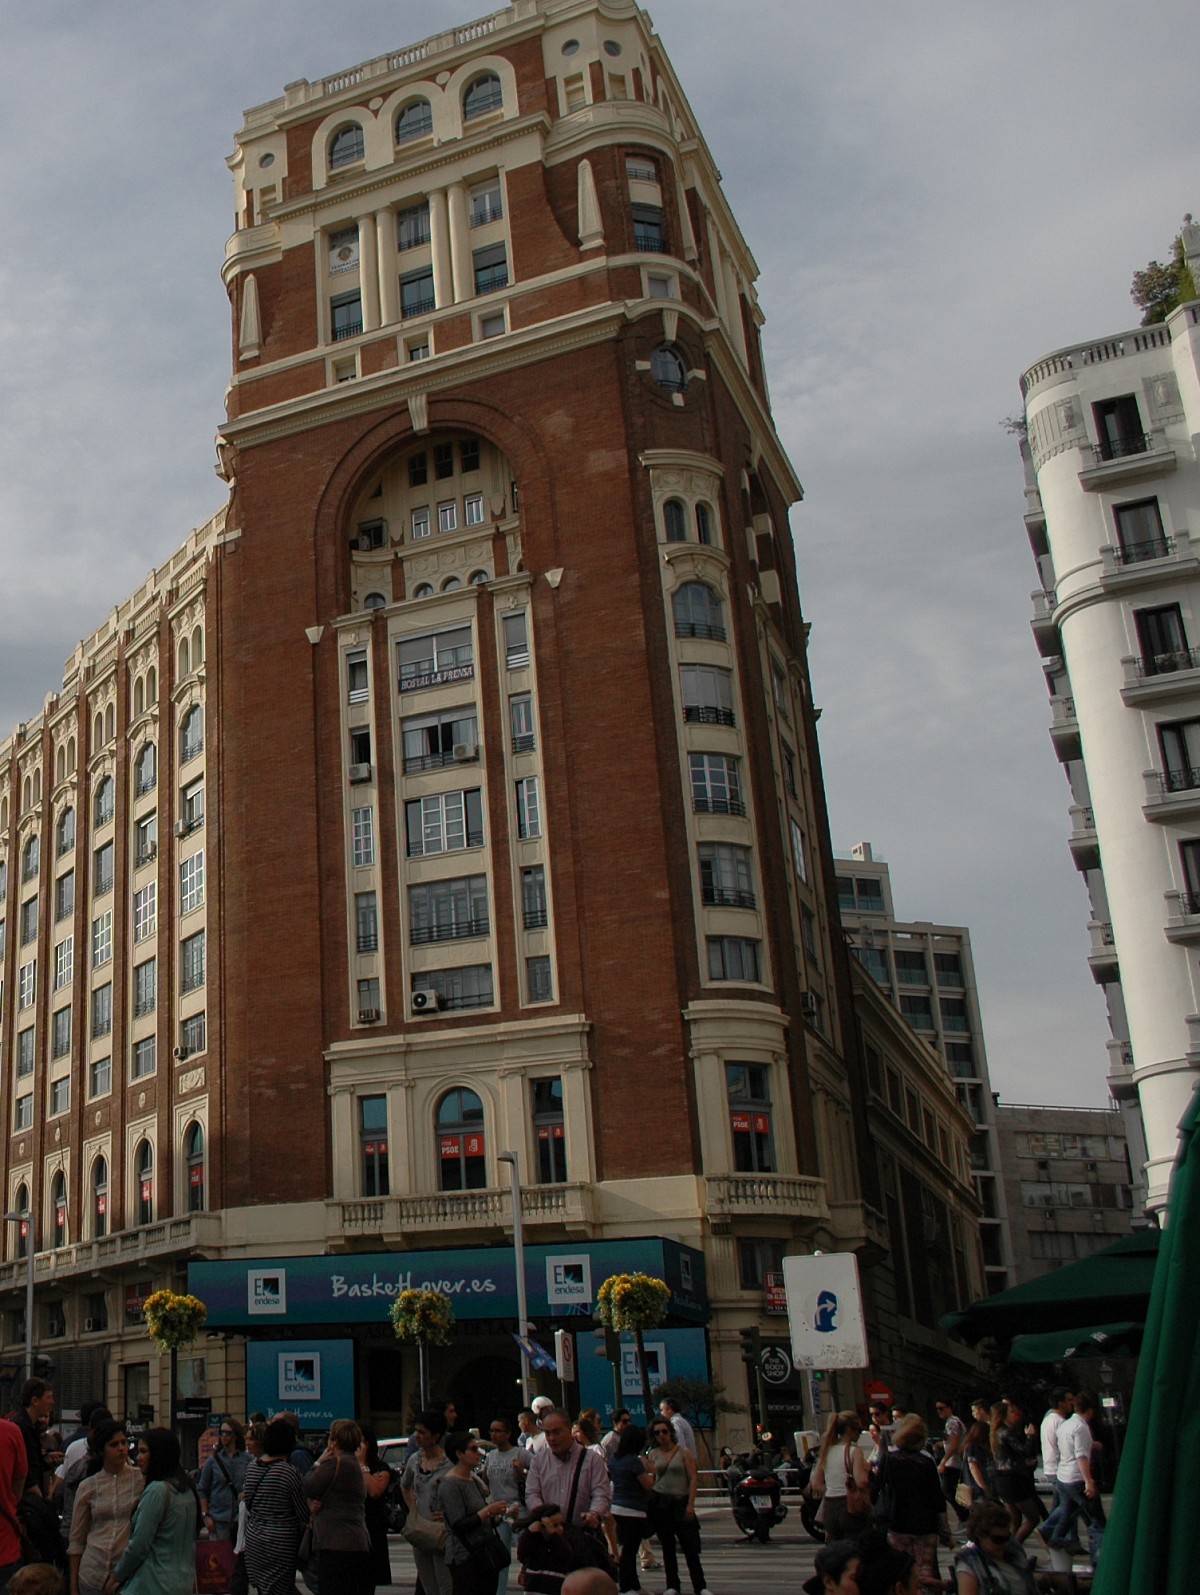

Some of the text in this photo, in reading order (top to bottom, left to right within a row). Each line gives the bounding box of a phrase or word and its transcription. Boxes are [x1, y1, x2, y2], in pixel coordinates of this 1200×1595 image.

[401, 666, 473, 690] HOSTAL LA PRENSA
[554, 1285, 584, 1295] endesa
[254, 1297, 279, 1305] endesa
[766, 1370, 785, 1378] SHOP
[624, 1376, 660, 1388] ensa
[285, 1383, 315, 1392] endesa
